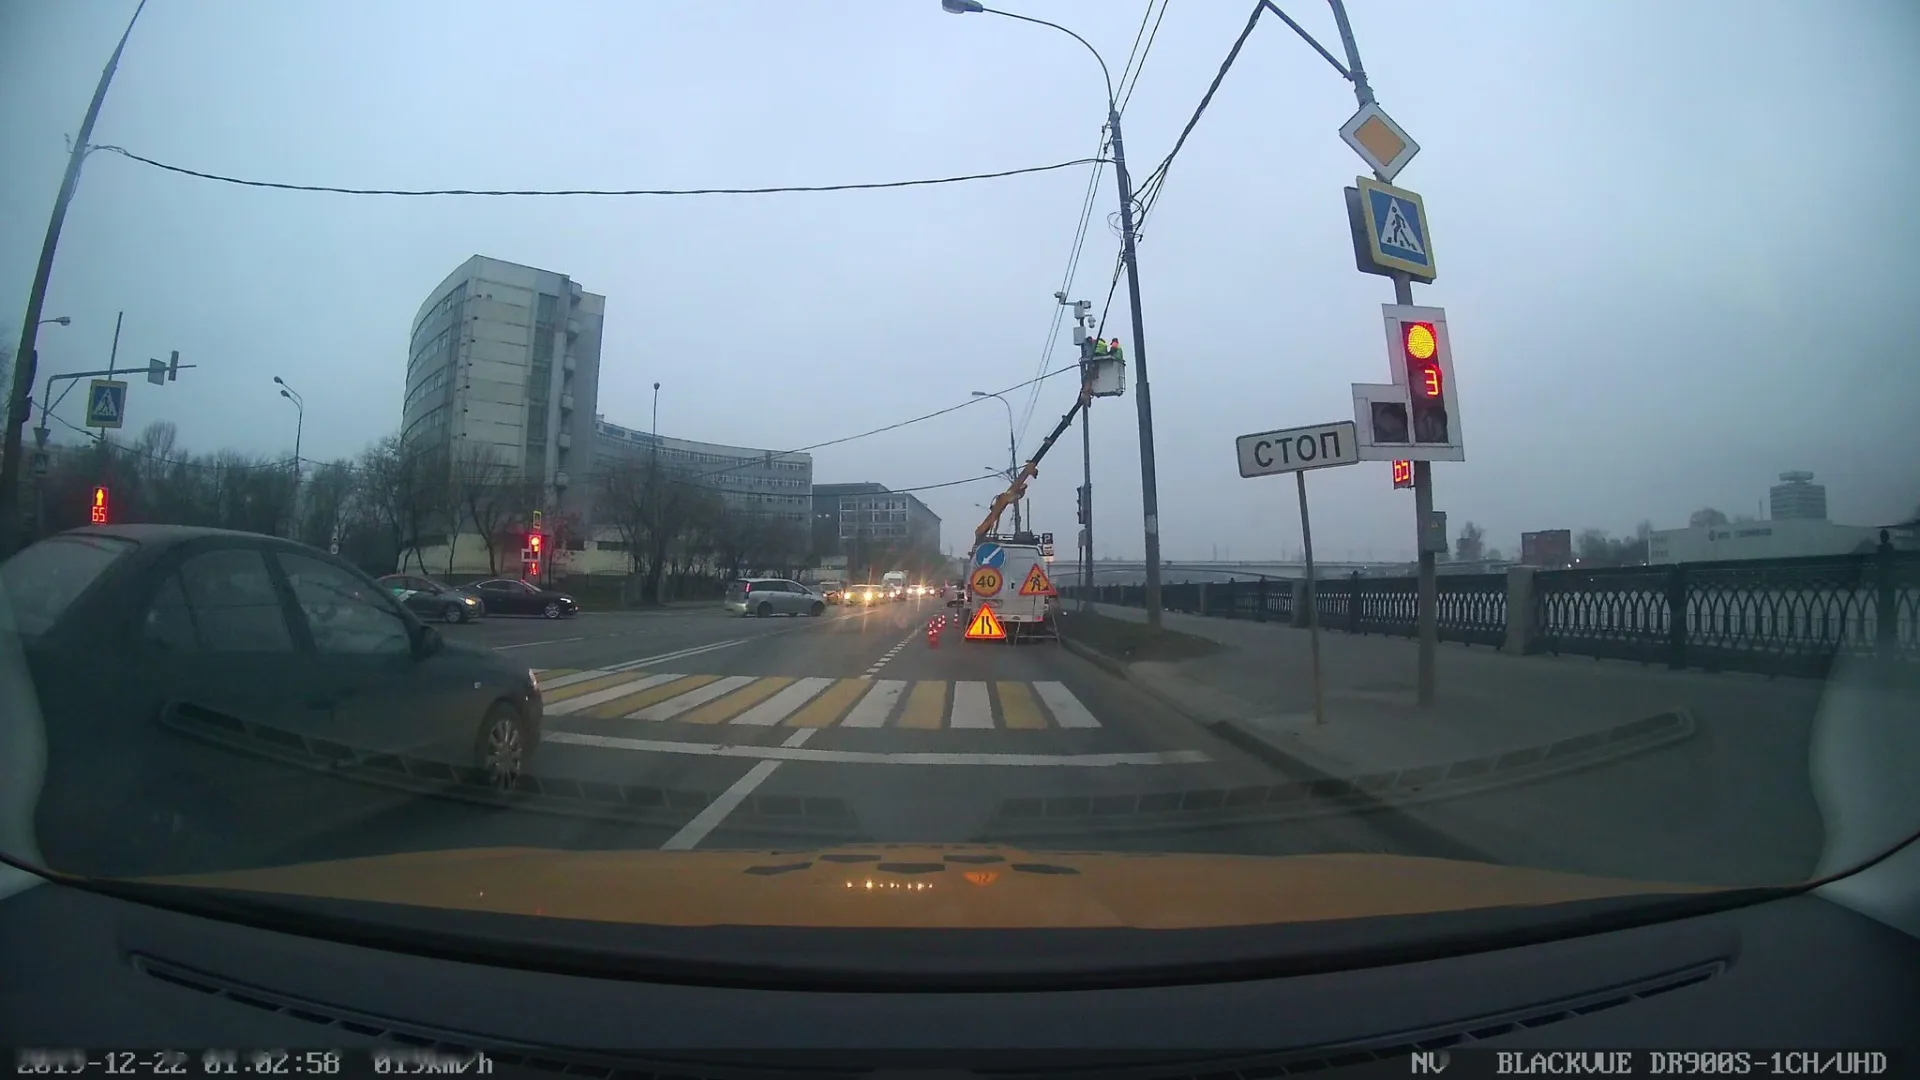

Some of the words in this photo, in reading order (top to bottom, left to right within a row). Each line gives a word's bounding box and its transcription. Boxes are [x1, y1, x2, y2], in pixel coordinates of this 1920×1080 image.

[1424, 369, 1439, 396] 3
[1254, 431, 1341, 468] СТОП
[92, 506, 105, 522] 65
[976, 575, 996, 588] 40
